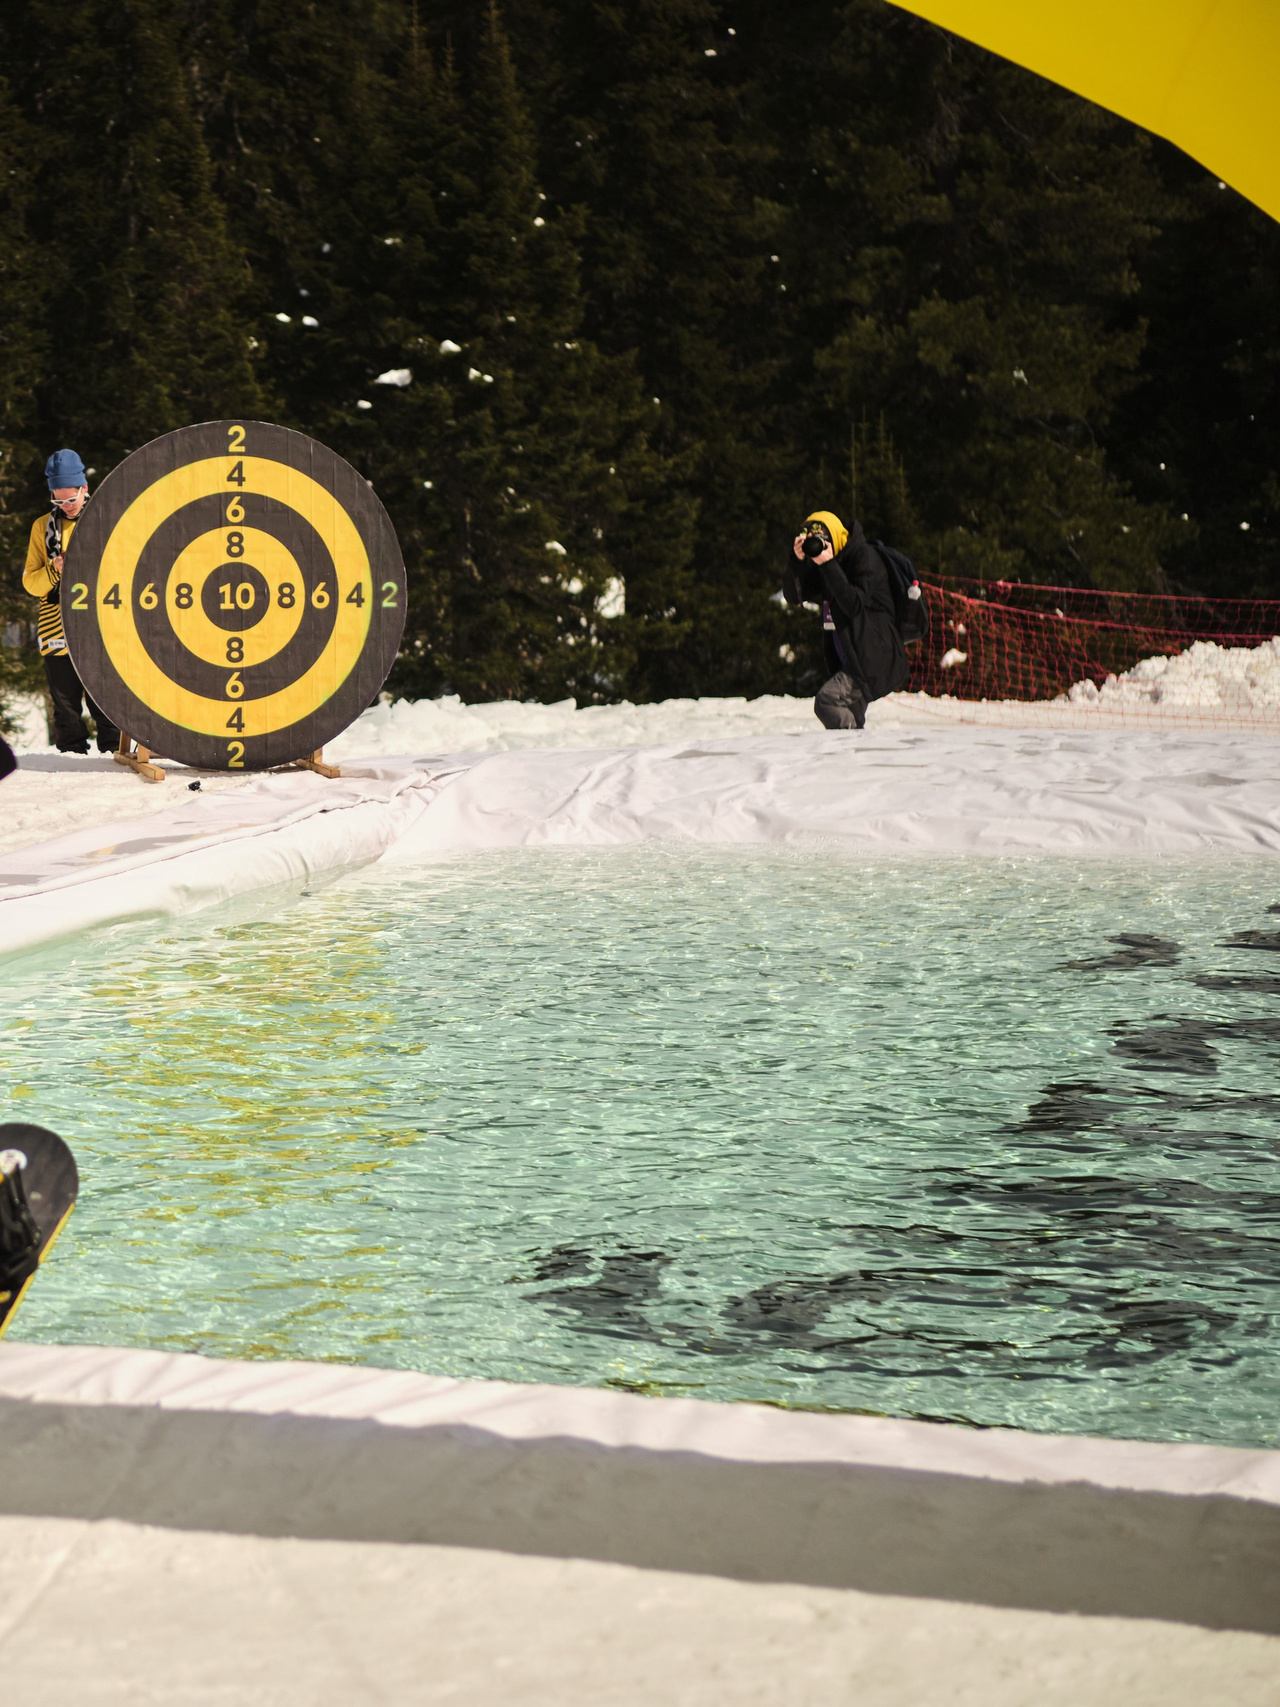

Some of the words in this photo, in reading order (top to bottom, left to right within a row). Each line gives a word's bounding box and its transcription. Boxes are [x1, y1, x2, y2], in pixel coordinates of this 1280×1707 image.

[227, 425, 246, 453] 2
[226, 461, 246, 487] 4
[225, 496, 245, 523] 6
[226, 532, 245, 558] 8
[71, 583, 89, 610] 2
[102, 583, 122, 610] 4
[139, 583, 159, 610] 6
[175, 583, 194, 610] 8
[219, 582, 256, 610] 10
[277, 583, 296, 609] 8
[311, 582, 330, 609] 6
[346, 582, 365, 608] 4
[381, 582, 398, 608] 2
[225, 637, 245, 664] 8
[225, 672, 245, 699] 6
[225, 707, 245, 733] 4
[226, 741, 245, 768] 2
